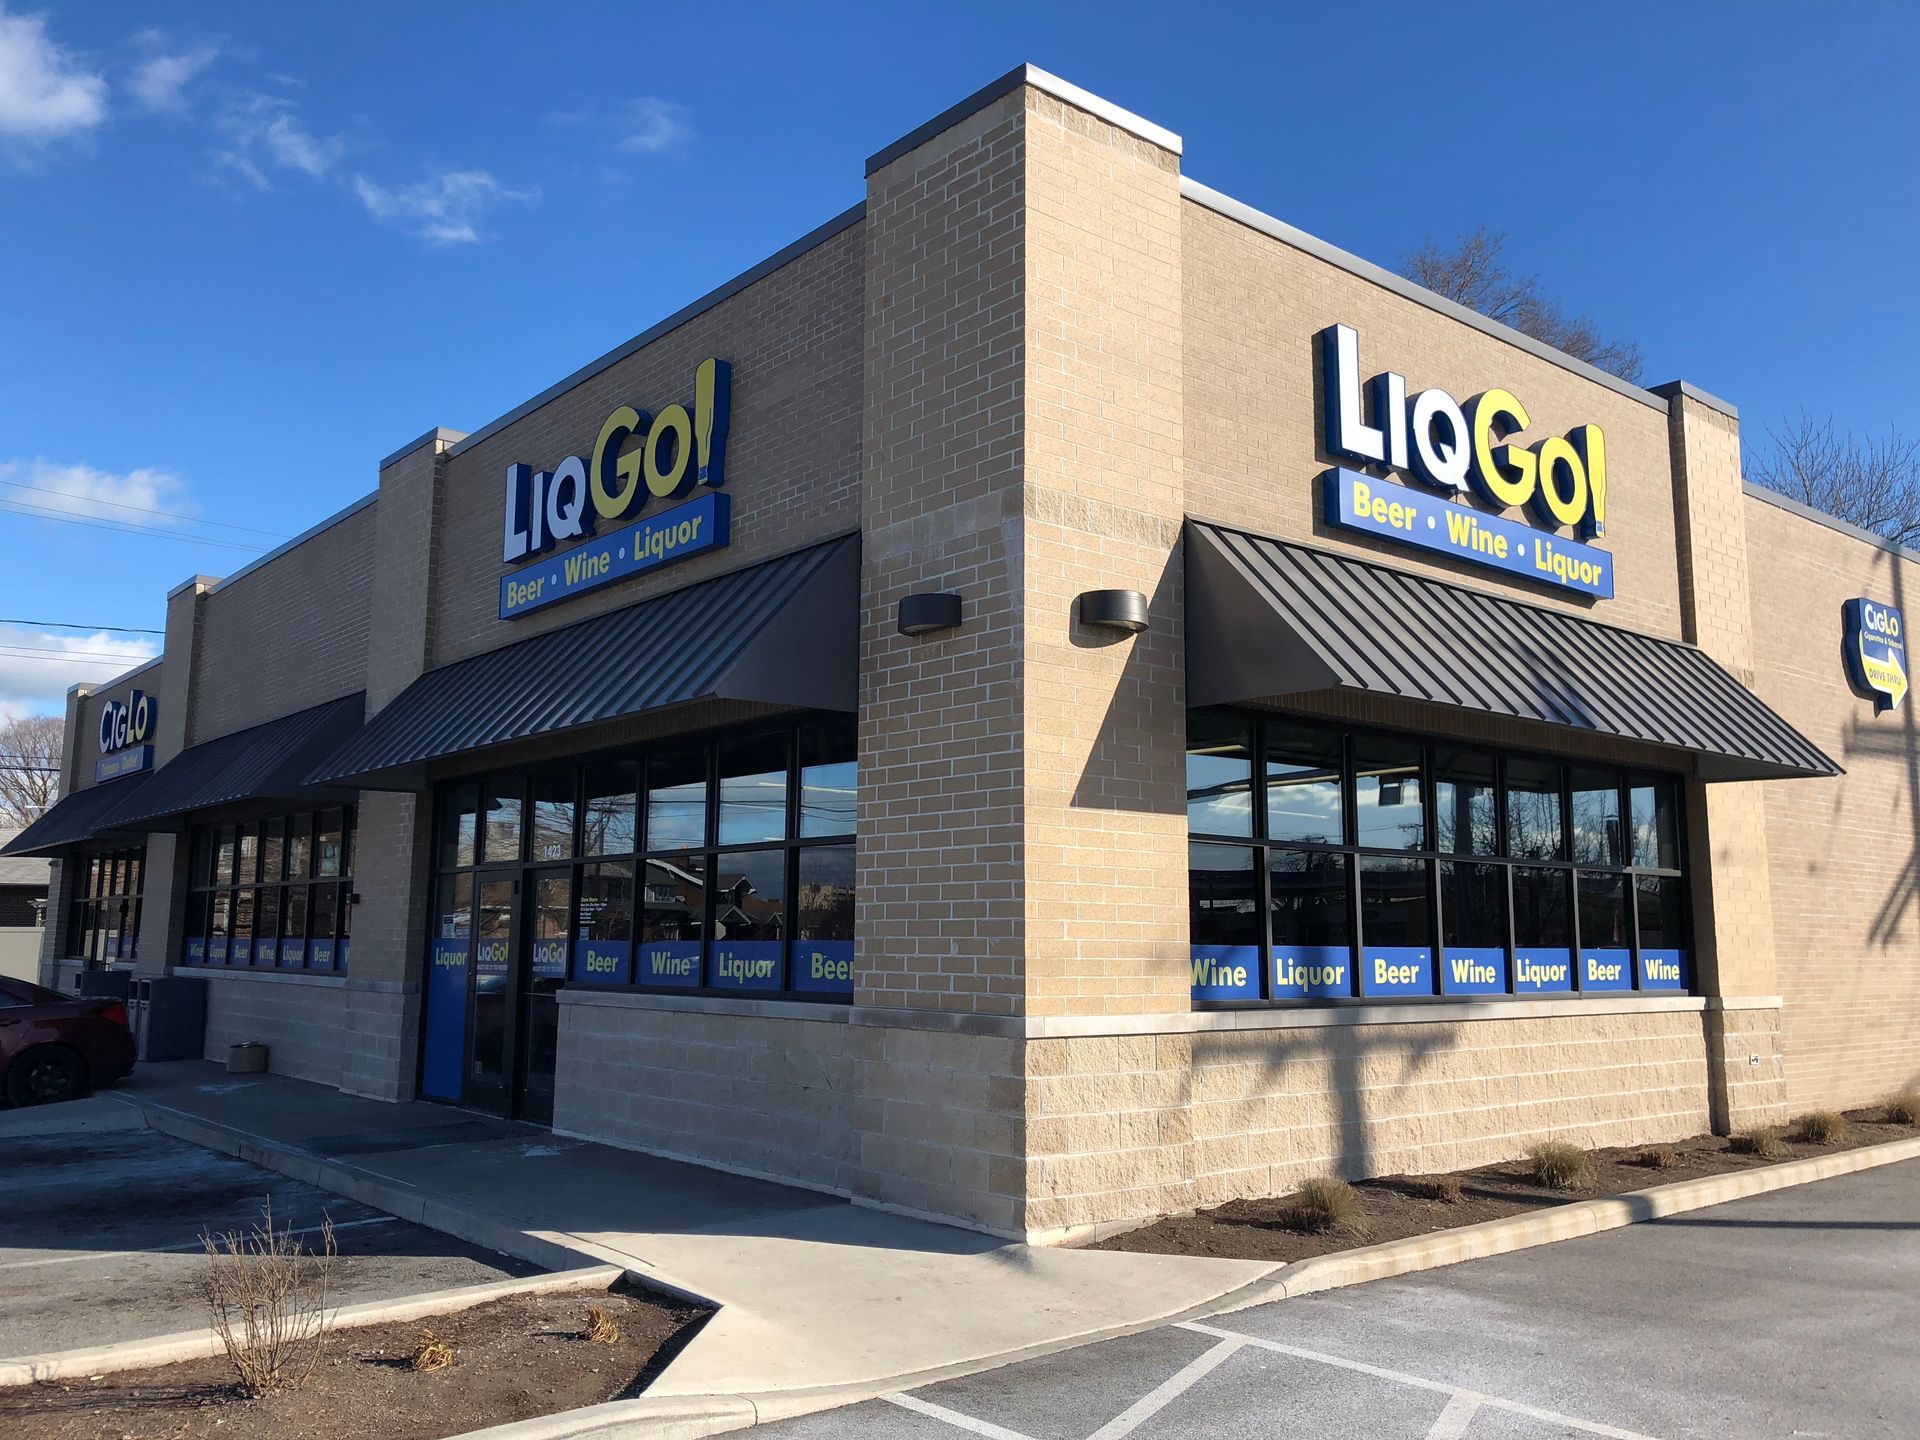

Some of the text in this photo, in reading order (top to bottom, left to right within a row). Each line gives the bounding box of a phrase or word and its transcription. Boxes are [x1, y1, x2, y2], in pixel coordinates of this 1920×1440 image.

[1353, 480, 1602, 586] Beer Wine Liquor
[507, 515, 702, 608] Beer Wine Liquor
[1868, 668, 1901, 686] DRIVE THRU
[190, 943, 203, 956] Wine
[235, 944, 249, 959] Beer
[258, 944, 275, 960] Wine
[282, 944, 303, 962] Liquor
[314, 946, 331, 962] Beer
[435, 947, 467, 970] Liquor
[587, 950, 619, 973] Beer
[651, 951, 691, 976] Wine
[719, 952, 776, 984] Liquor
[1190, 958, 1247, 987] Wine
[1374, 958, 1420, 985] Beer
[1451, 959, 1496, 983] Wine
[1588, 959, 1621, 981] Beer
[1644, 959, 1680, 980] Wine
[1276, 957, 1345, 993] Liquor
[1516, 959, 1567, 988] Liquor
